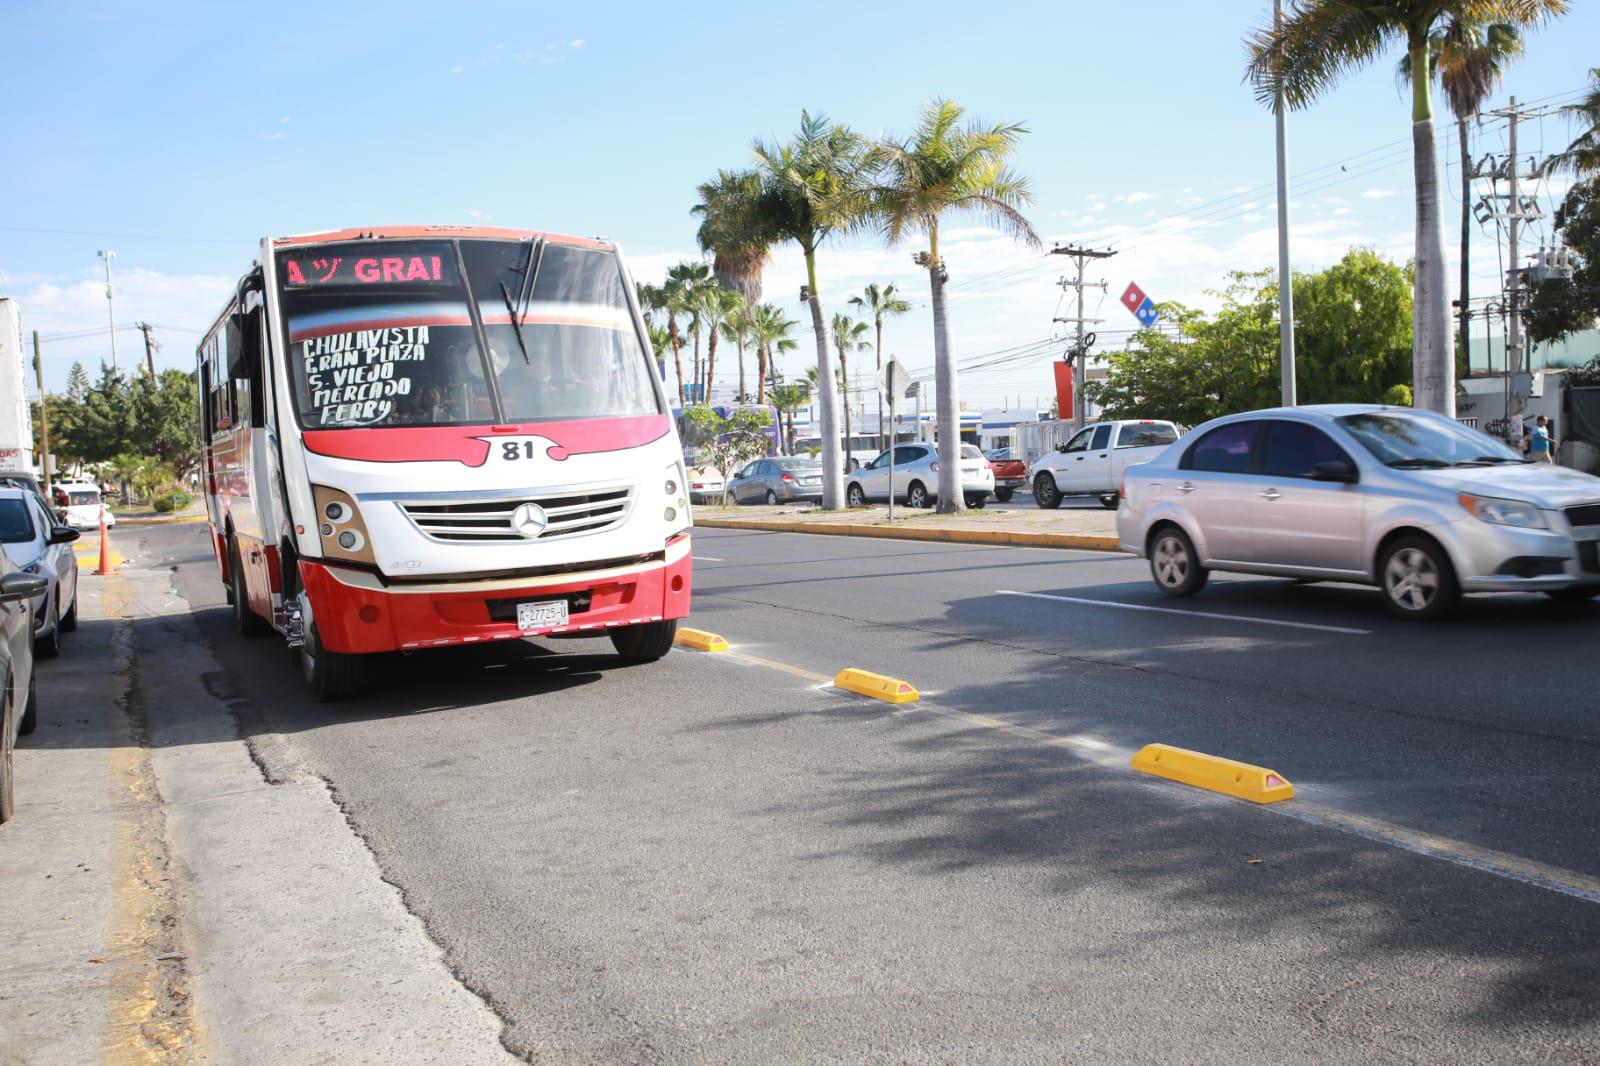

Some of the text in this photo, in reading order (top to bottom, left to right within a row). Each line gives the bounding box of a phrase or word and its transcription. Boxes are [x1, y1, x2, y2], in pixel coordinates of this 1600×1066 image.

[365, 343, 426, 364] PLAZA
[333, 362, 395, 387] VIEJO
[313, 377, 411, 408] MERCADO
[320, 400, 392, 426] FERRY
[502, 441, 533, 461] 81
